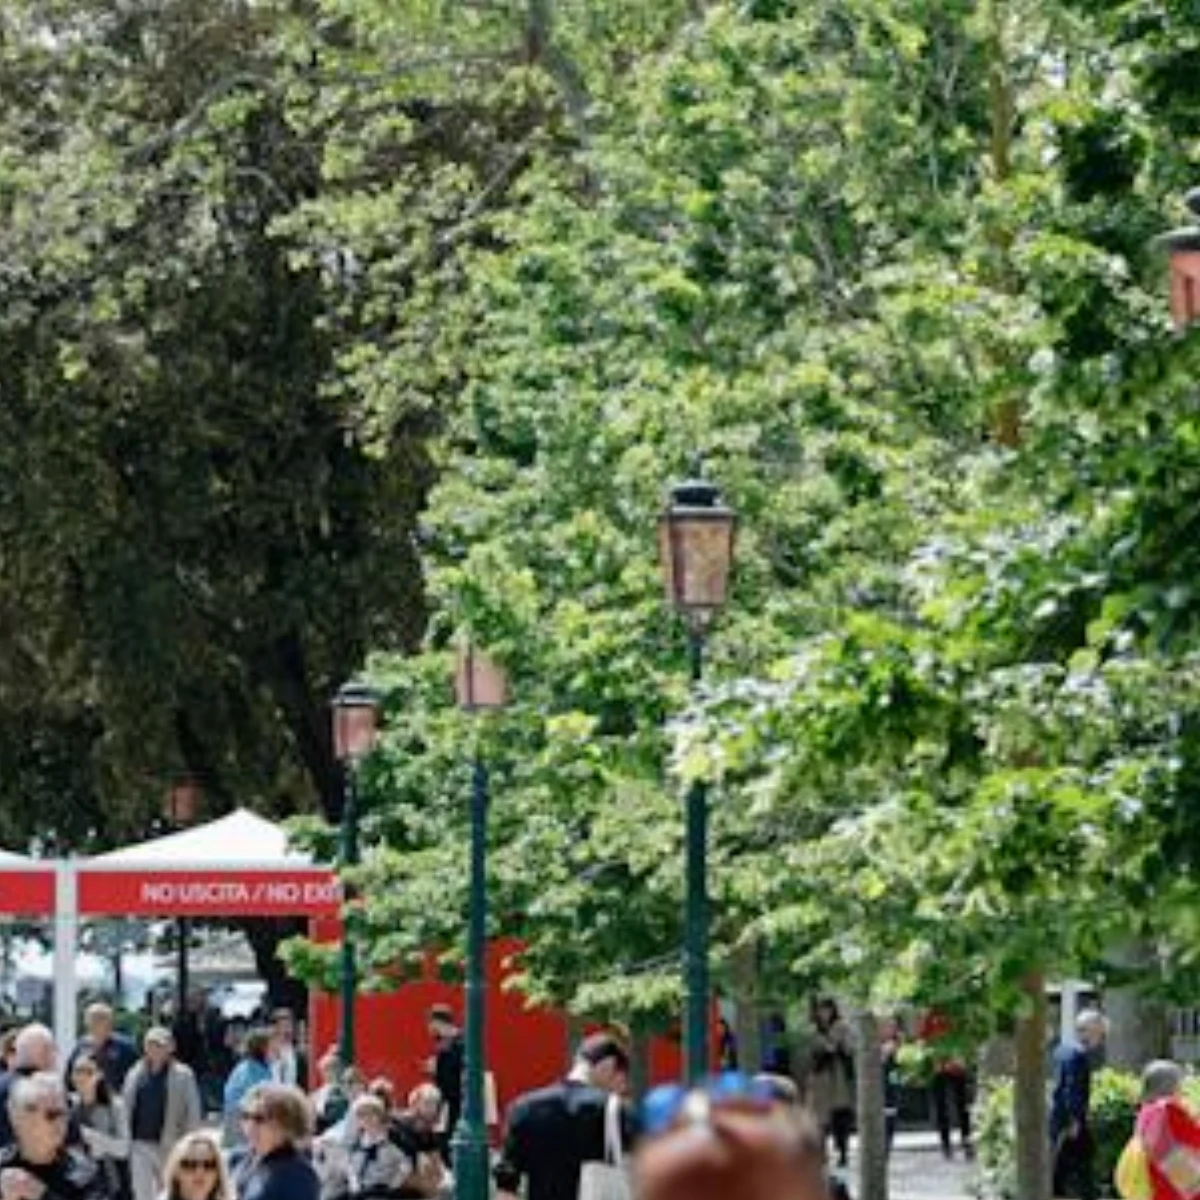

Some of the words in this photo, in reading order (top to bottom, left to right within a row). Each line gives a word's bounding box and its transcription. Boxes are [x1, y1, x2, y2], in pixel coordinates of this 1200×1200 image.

[142, 882, 175, 903] NO
[179, 882, 249, 903] USCITA
[267, 882, 300, 903] NO
